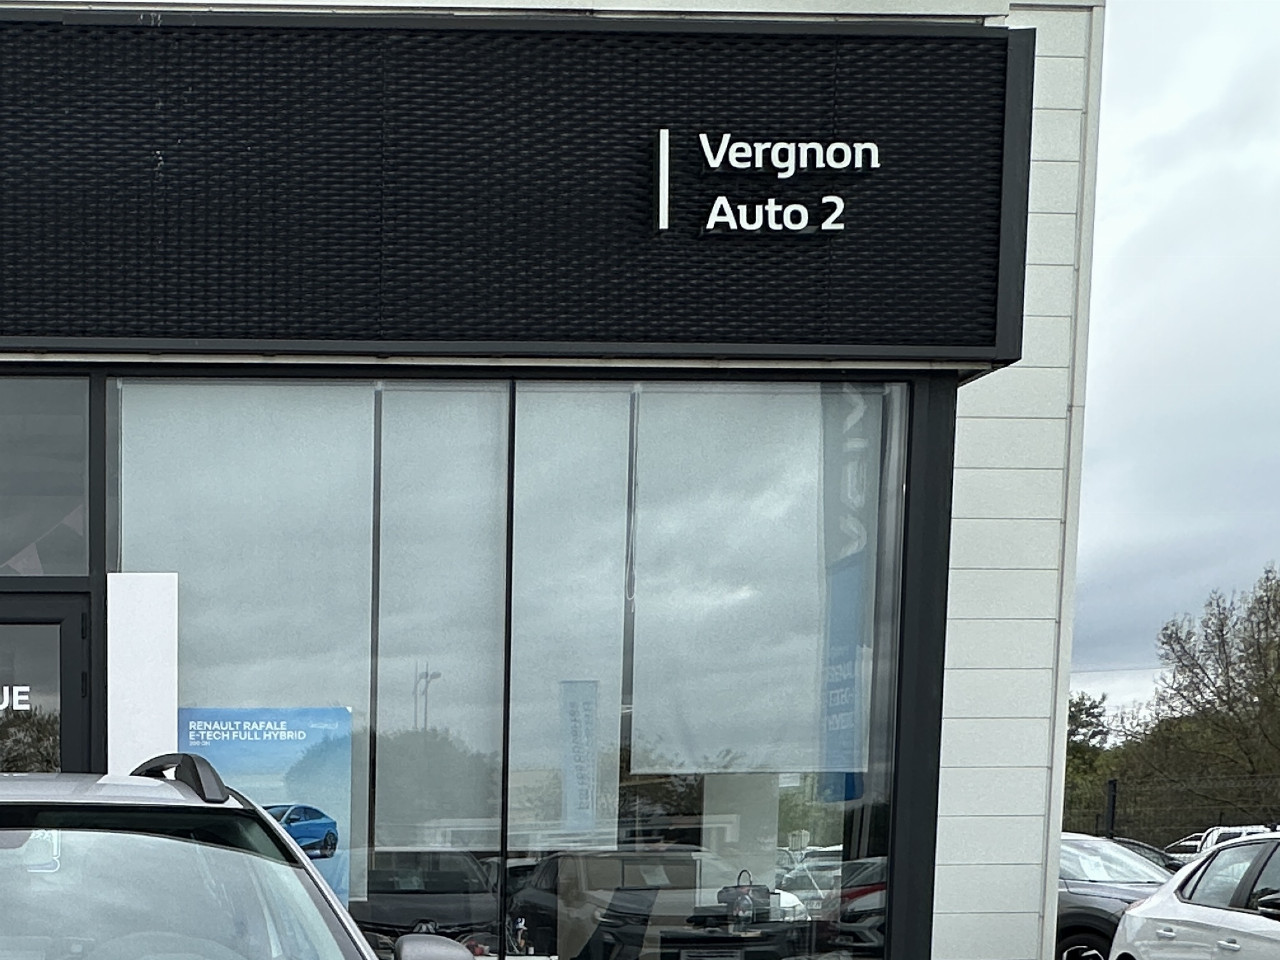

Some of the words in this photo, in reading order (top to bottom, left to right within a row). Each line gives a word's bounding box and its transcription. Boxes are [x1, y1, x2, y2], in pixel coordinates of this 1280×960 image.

[699, 133, 881, 179] Vergnon
[706, 195, 809, 231] Auto
[820, 195, 845, 230] 2
[189, 720, 241, 731] RENAULT
[243, 720, 287, 731] RAFALE
[189, 730, 230, 741] E-TECH
[232, 730, 261, 741] FULL
[263, 730, 307, 741] HYBRID
